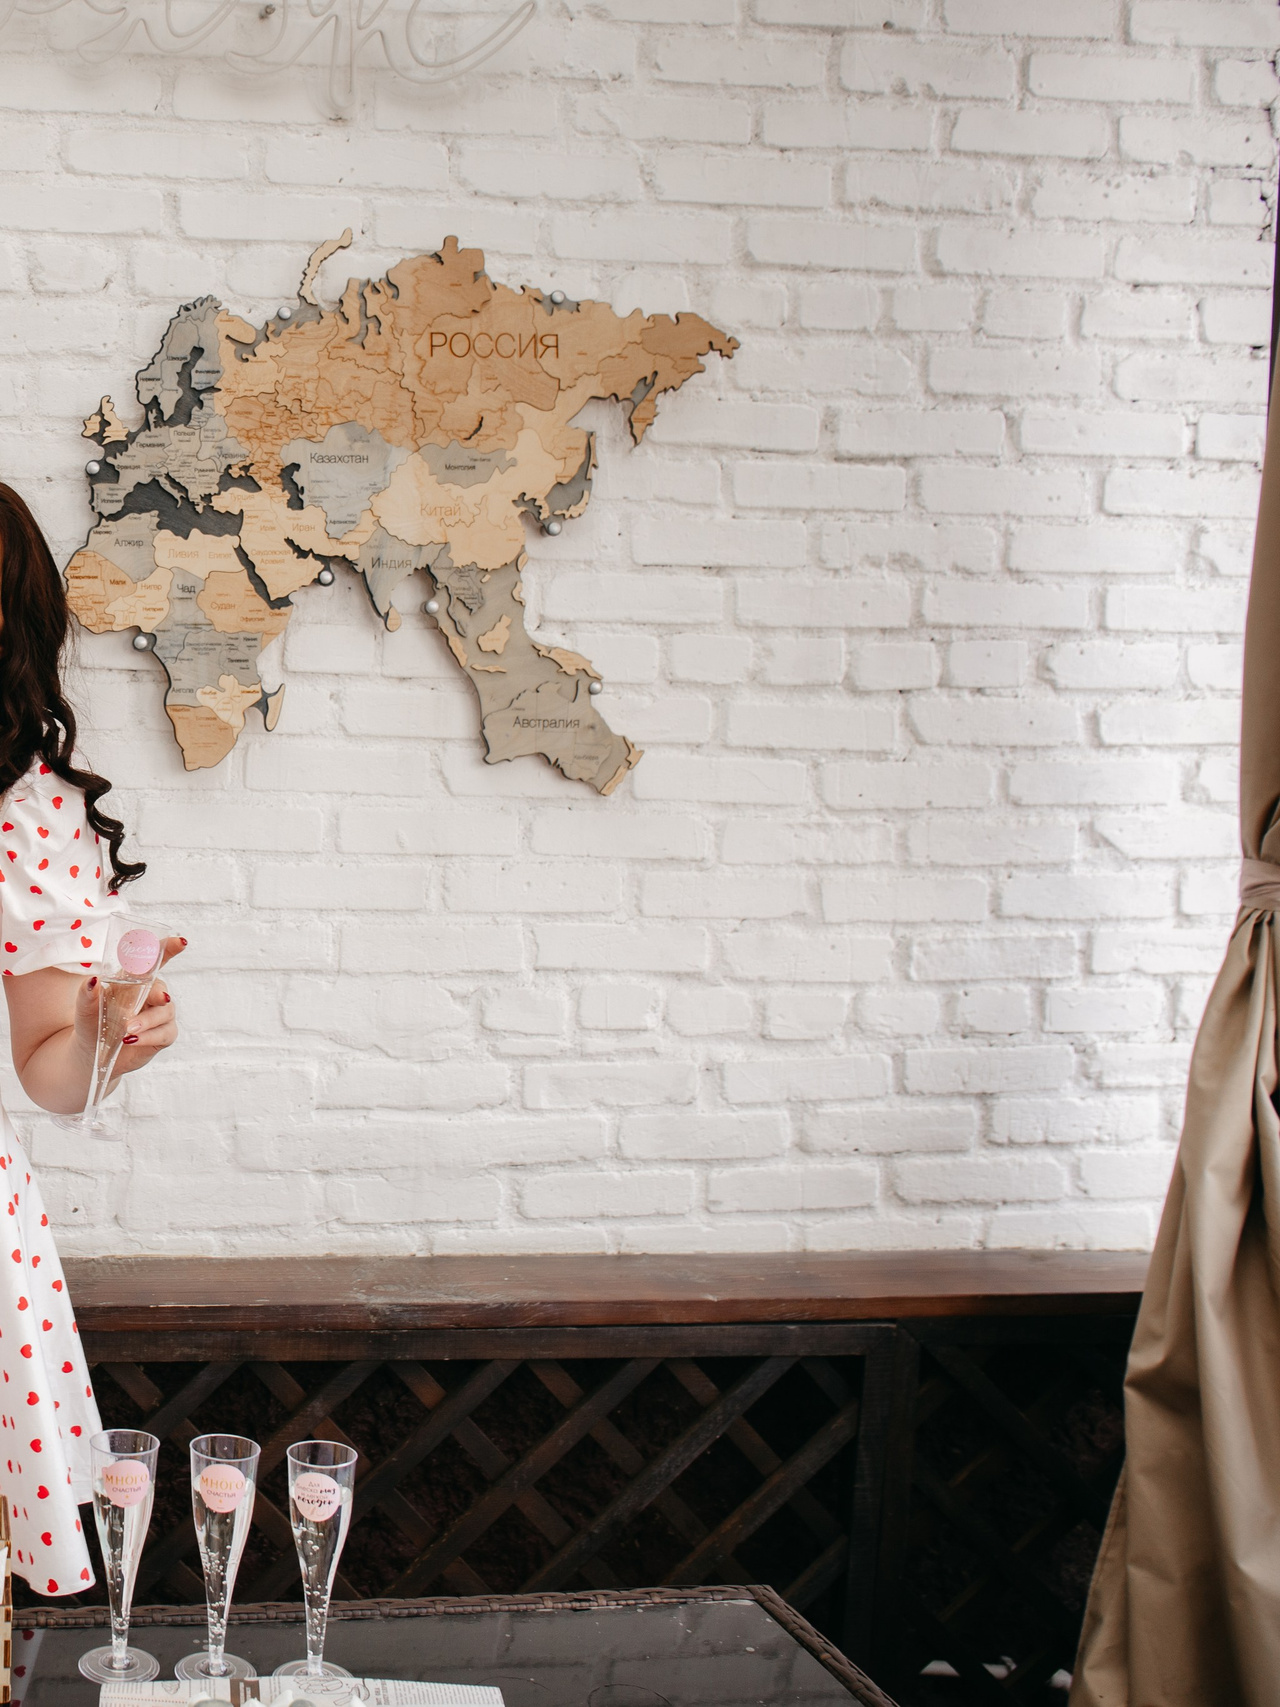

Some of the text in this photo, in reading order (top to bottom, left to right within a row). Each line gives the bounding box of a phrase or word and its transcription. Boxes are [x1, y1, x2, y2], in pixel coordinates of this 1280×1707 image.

[429, 331, 560, 360] РОССИЯ
[173, 429, 196, 438] Польша
[135, 441, 166, 450] Германия
[217, 451, 246, 462] Украина
[308, 452, 370, 465] Казахстан
[444, 463, 477, 472] Монголия
[420, 502, 463, 517] Китай
[291, 523, 316, 534] Иран
[113, 538, 144, 550] Алжир
[167, 547, 199, 561] Ливия
[207, 550, 233, 561] Египет
[371, 556, 413, 571] Индия
[109, 578, 127, 586] Мали
[140, 582, 163, 593] Нигер
[176, 582, 197, 596] Чад
[209, 601, 237, 613] Судан
[171, 685, 195, 695] Ангола
[512, 715, 581, 733] Австралия
[105, 1472, 149, 1486] МНОГО
[200, 1474, 245, 1492] МНОГО
